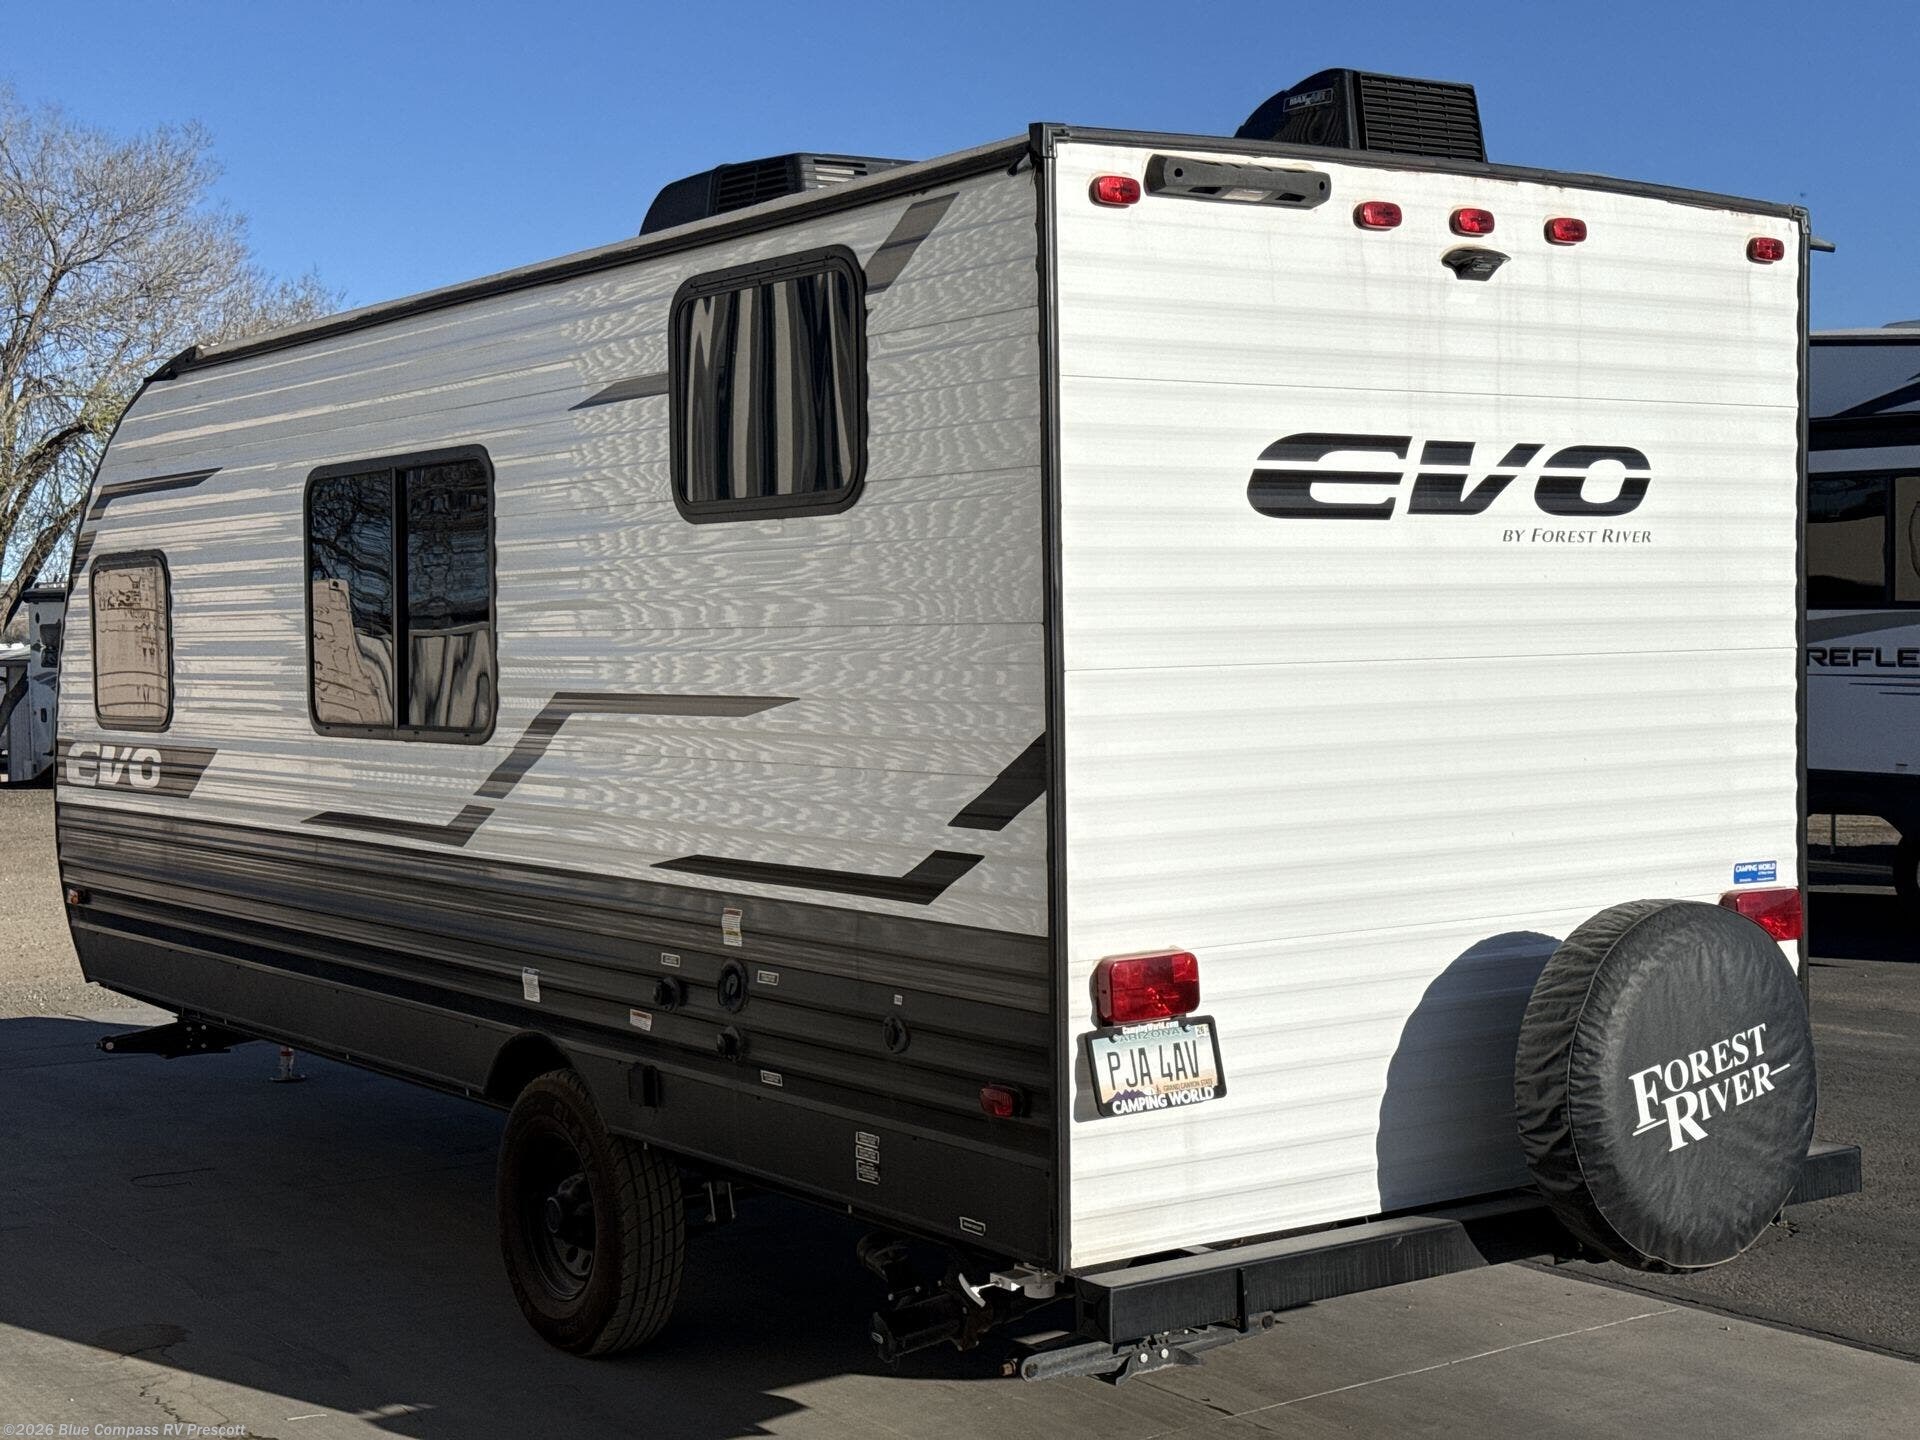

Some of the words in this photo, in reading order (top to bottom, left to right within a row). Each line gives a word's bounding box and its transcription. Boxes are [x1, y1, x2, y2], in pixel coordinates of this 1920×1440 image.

[1246, 432, 1652, 520] EVO
[1531, 528, 1597, 543] FOREST
[1601, 528, 1652, 543] RIVER
[1807, 646, 1920, 667] REFLE
[66, 742, 162, 789] EVO
[1120, 1028, 1180, 1042] ARIZONA
[1107, 1047, 1153, 1091] PJA
[1159, 1039, 1200, 1082] 4AV
[1628, 1023, 1767, 1129] FOREST
[1112, 1093, 1169, 1115] CAMPING
[1170, 1087, 1215, 1105] WORLD
[1661, 1062, 1776, 1152] RIVER
